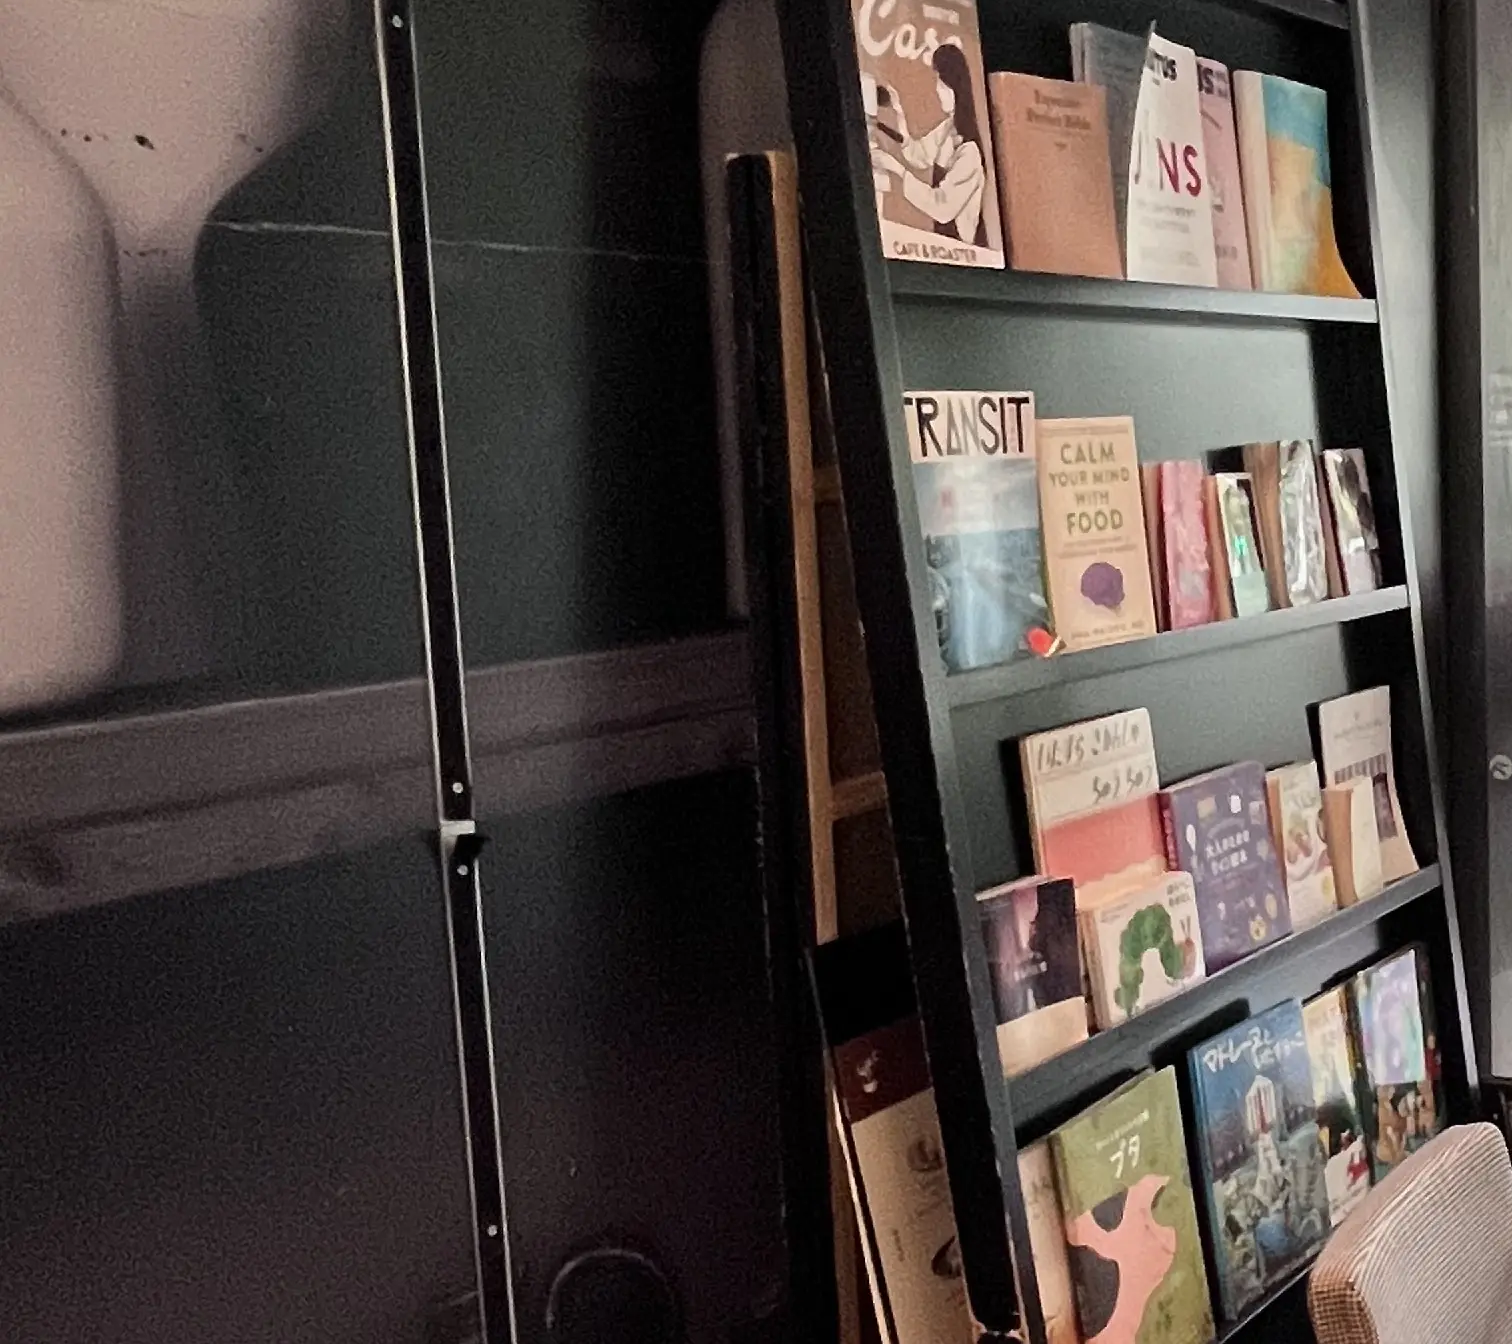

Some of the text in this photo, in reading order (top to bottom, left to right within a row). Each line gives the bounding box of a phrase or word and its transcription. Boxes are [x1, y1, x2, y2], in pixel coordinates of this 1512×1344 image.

[1060, 442, 1115, 465] CALM
[1049, 468, 1130, 488] YOUR MIND
[1075, 491, 1109, 506] WITH
[1066, 511, 1123, 536] FOOD
